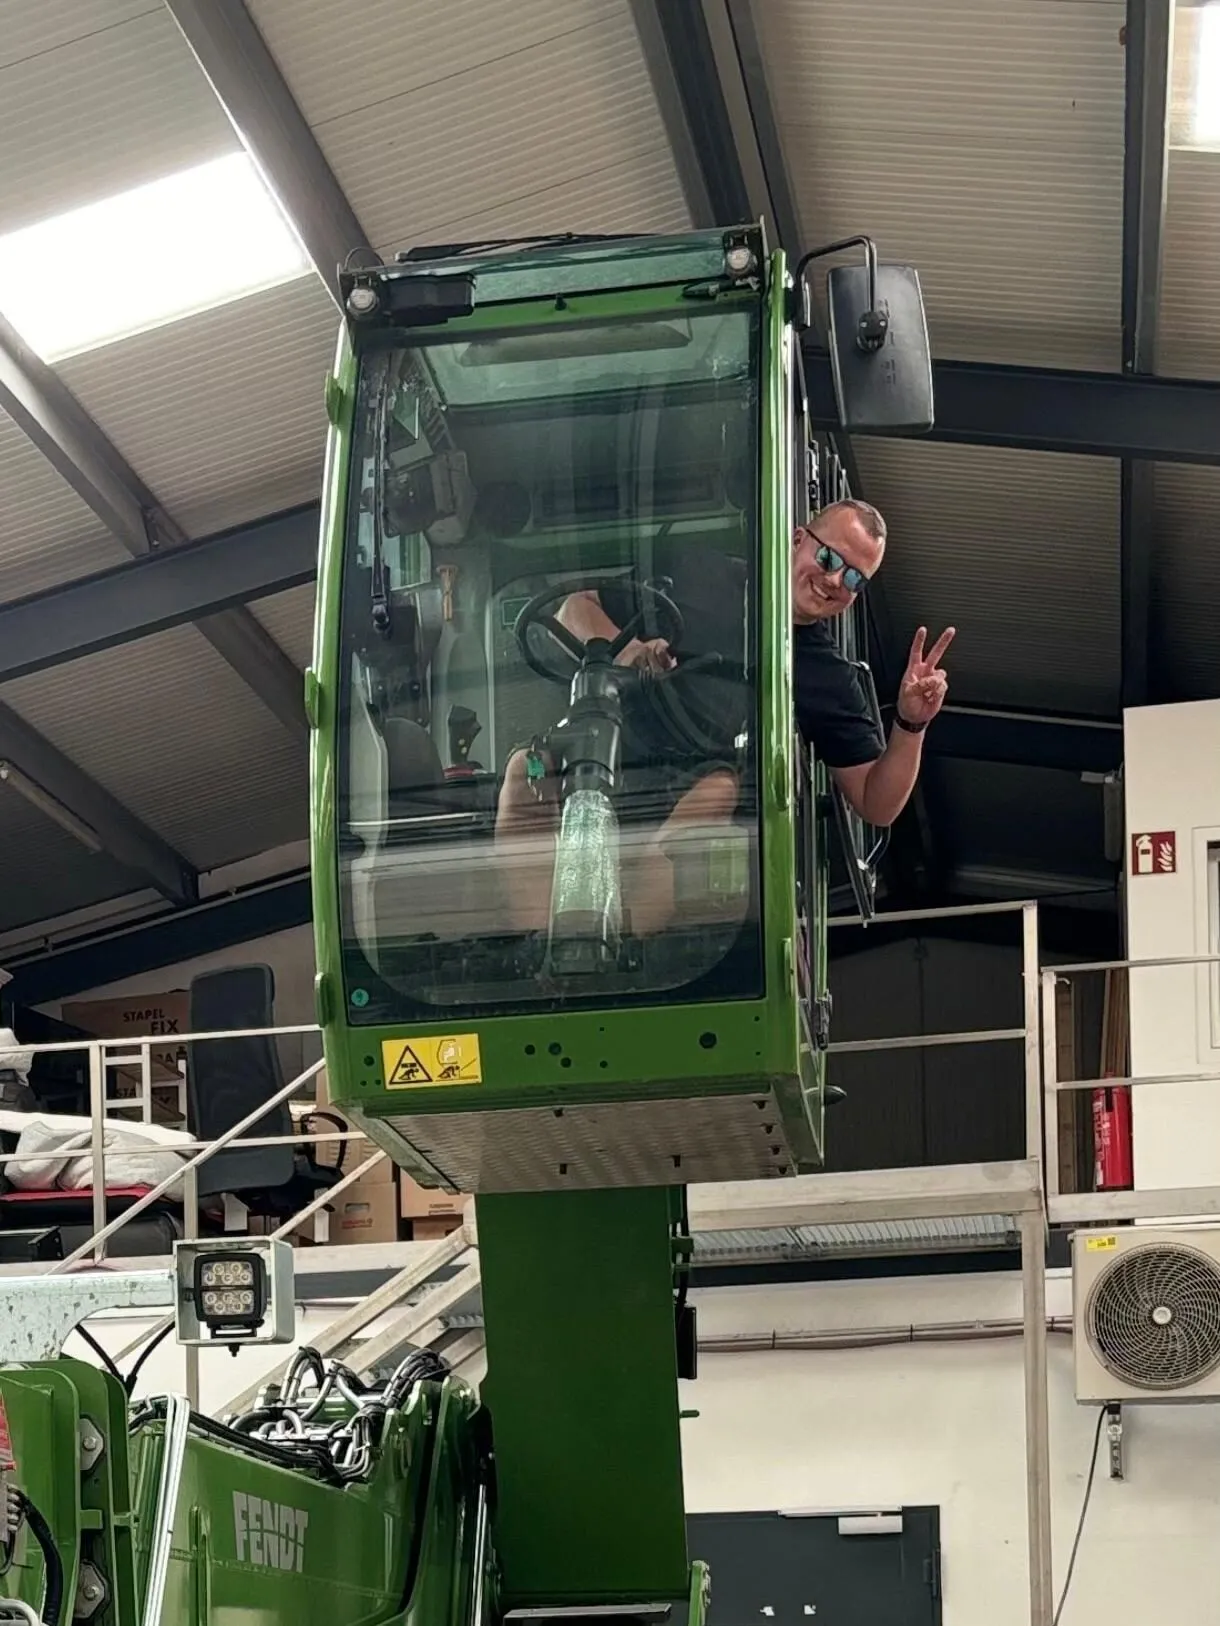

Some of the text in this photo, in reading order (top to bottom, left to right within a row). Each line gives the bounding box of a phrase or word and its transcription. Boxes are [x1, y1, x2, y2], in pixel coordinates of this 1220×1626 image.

[123, 1008, 165, 1022] STAPEL
[151, 1019, 179, 1034] FIX
[232, 1490, 309, 1573] FENDT
